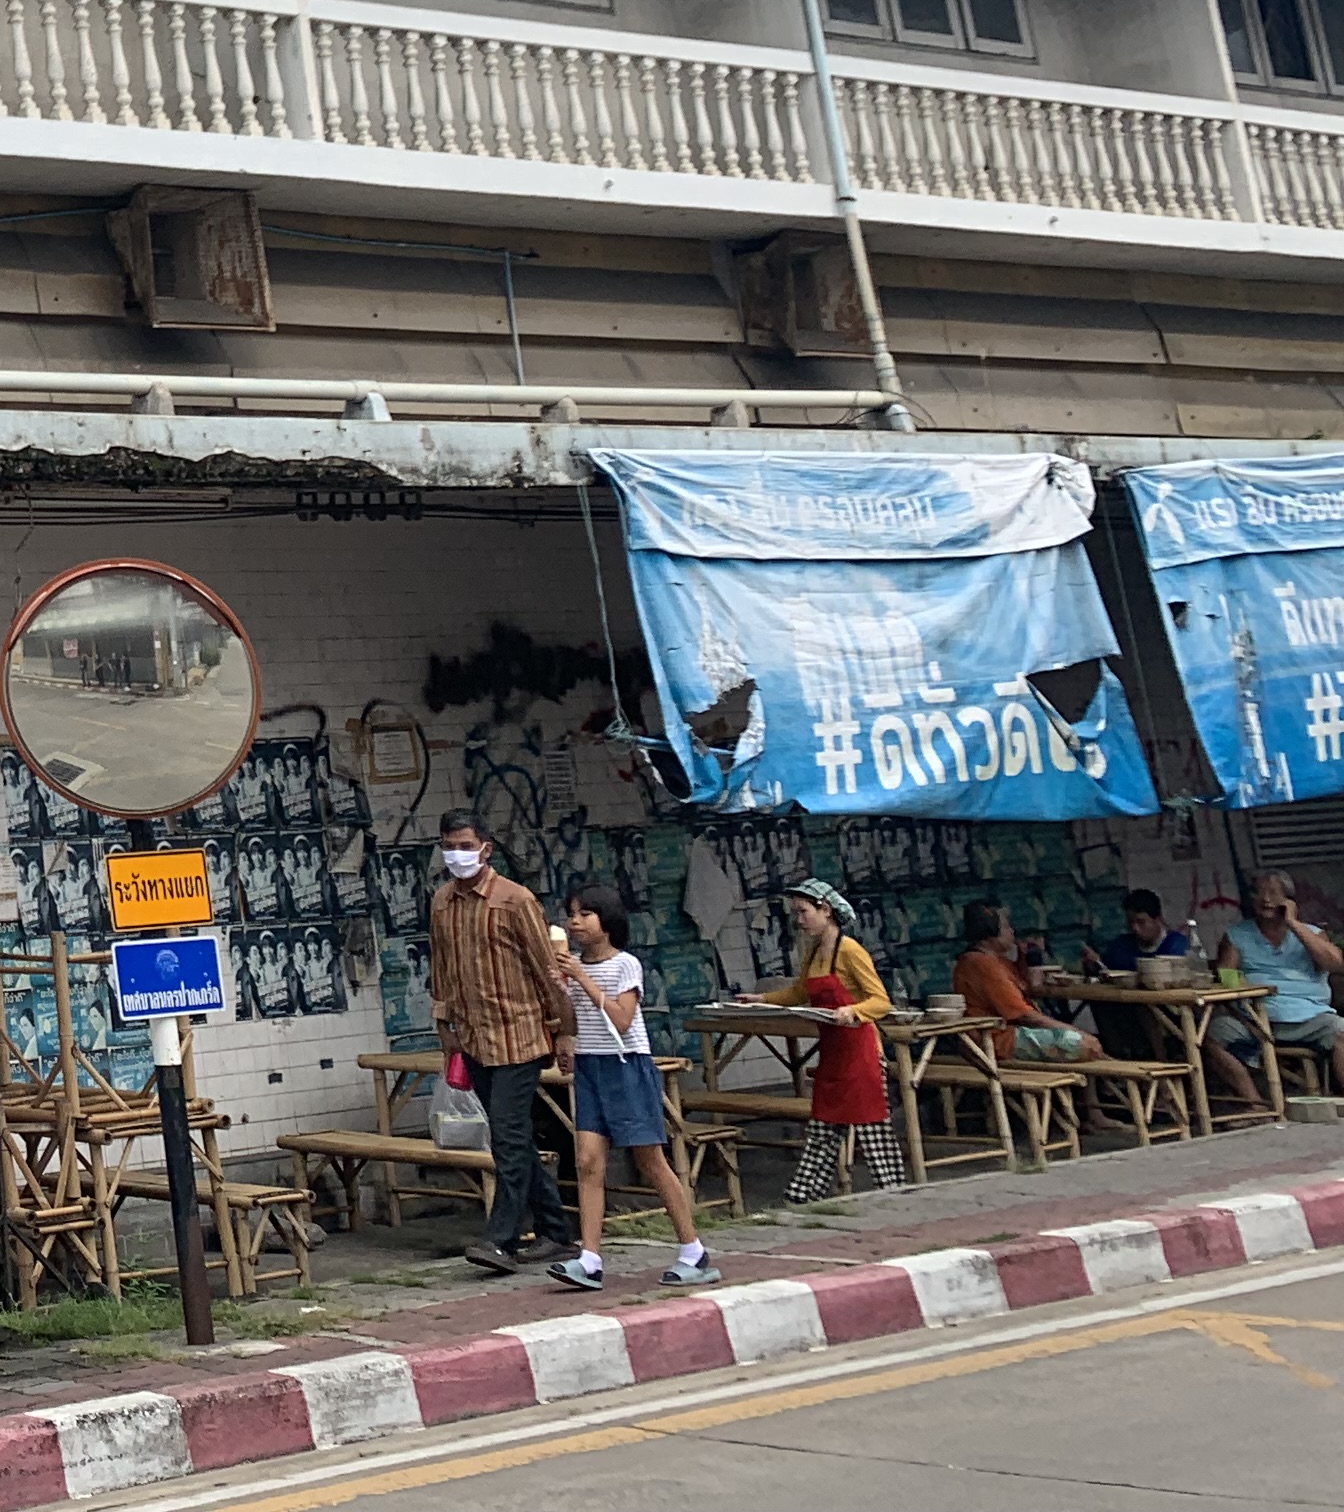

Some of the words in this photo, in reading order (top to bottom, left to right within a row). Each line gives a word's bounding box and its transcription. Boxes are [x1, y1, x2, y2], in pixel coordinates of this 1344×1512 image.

[114, 872, 205, 904] ระวังทางแยก
